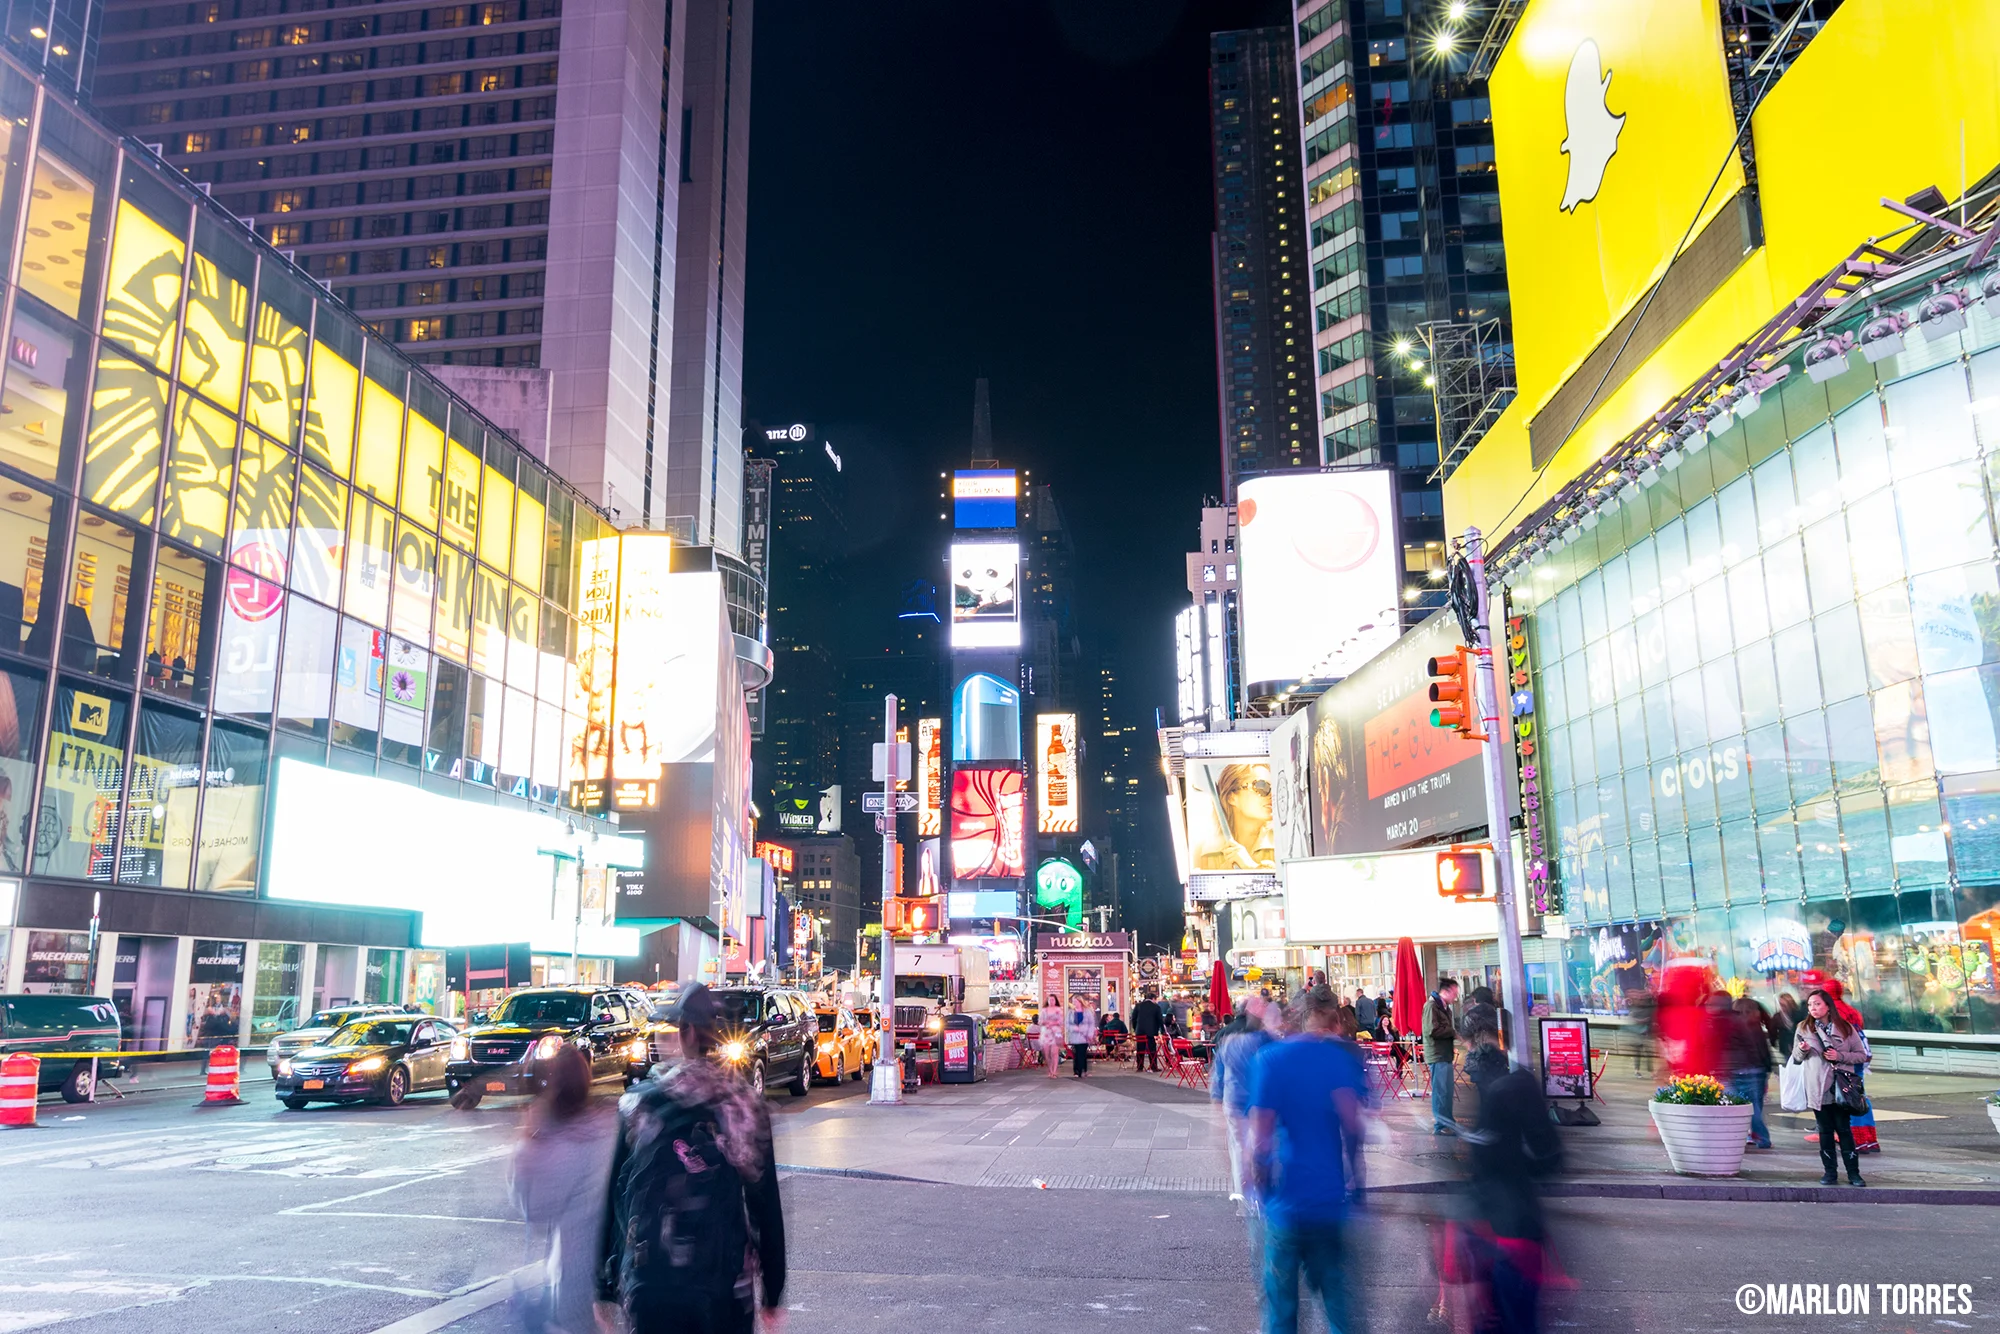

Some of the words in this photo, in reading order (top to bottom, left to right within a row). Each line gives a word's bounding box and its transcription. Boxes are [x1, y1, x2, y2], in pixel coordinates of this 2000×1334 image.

[427, 465, 476, 533] THE
[361, 484, 450, 603] LION
[748, 488, 766, 577] TIMES
[452, 540, 529, 643] KING
[1510, 617, 1528, 686] TOYS
[1377, 684, 1400, 711] SEAN
[79, 702, 104, 728] MTV
[1368, 728, 1402, 778] THE
[1519, 721, 1534, 756] US
[1660, 748, 1739, 797] crocs
[1384, 791, 1400, 809] ARMED
[1401, 785, 1417, 803] WITH
[1418, 779, 1429, 796] THE
[1430, 772, 1451, 791] TRUTH
[1386, 820, 1408, 841] MARCH
[1409, 817, 1419, 836] 20
[1534, 882, 1548, 912] US
[32, 951, 90, 961] SKECHERS
[1050, 936, 1114, 948] nuchas
[197, 956, 240, 965] SKECHERS
[914, 955, 922, 966] 7
[945, 1030, 967, 1044] JERSEY
